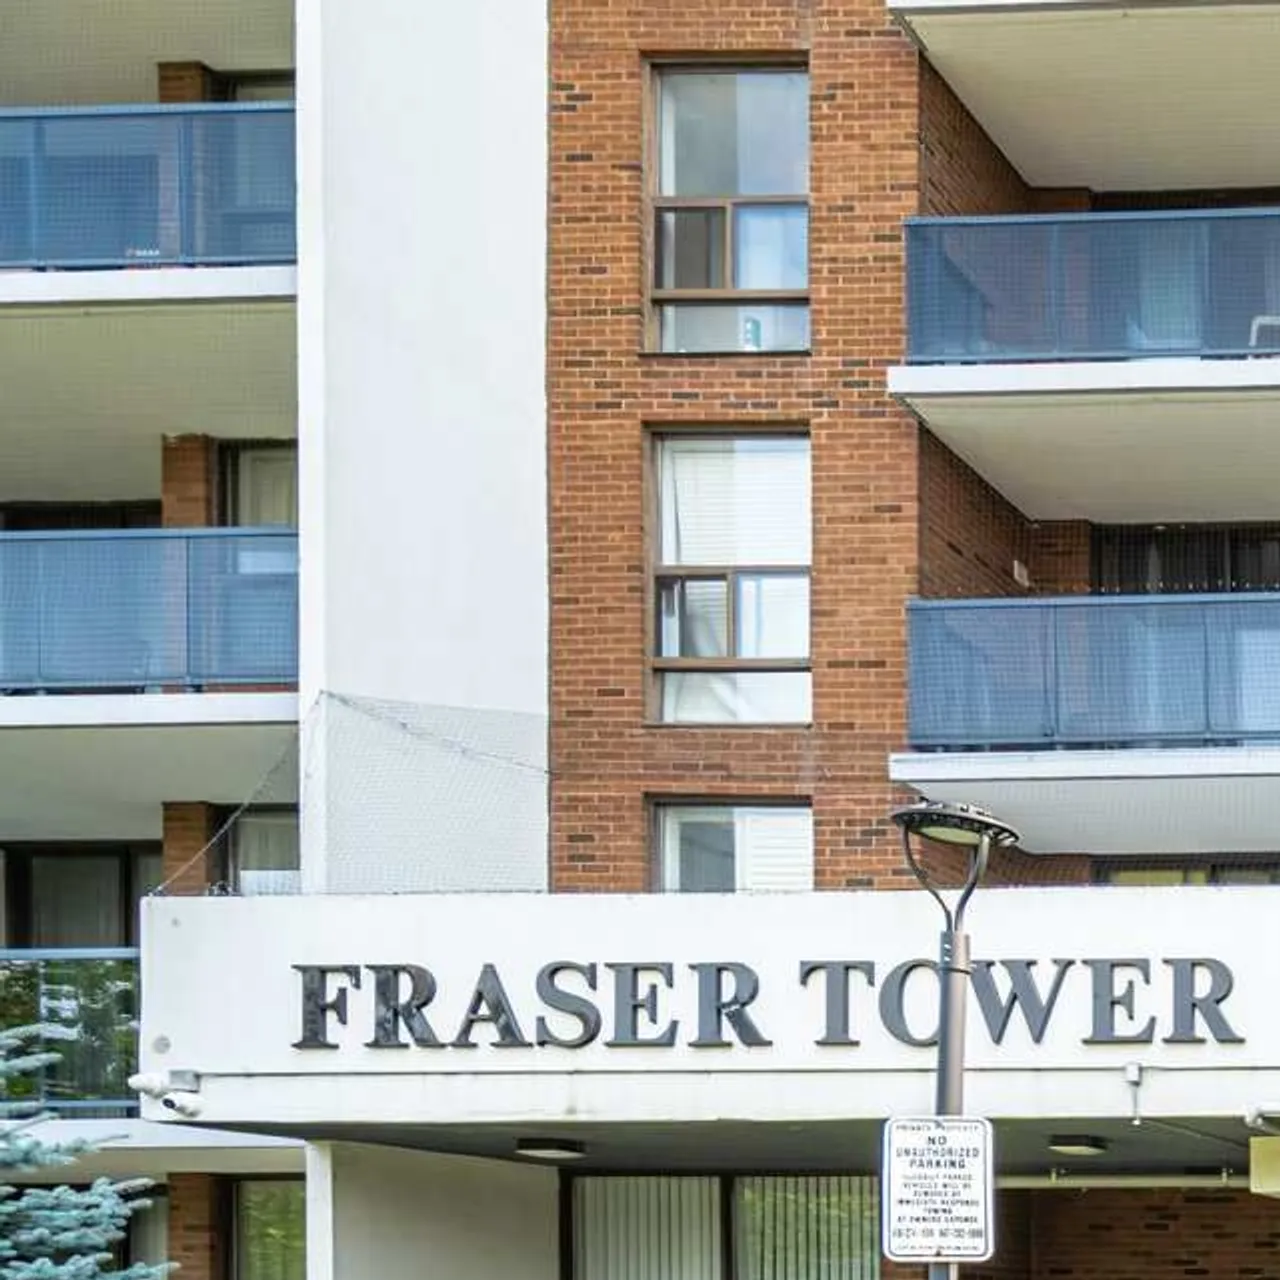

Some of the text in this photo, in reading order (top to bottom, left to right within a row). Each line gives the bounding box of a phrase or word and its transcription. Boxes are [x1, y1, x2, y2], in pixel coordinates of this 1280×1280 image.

[292, 958, 1246, 1050] FRASER TOWER
[927, 1136, 947, 1146] NO
[896, 1147, 981, 1158] UNAUTHORIZED
[910, 1159, 966, 1169] PARKING
